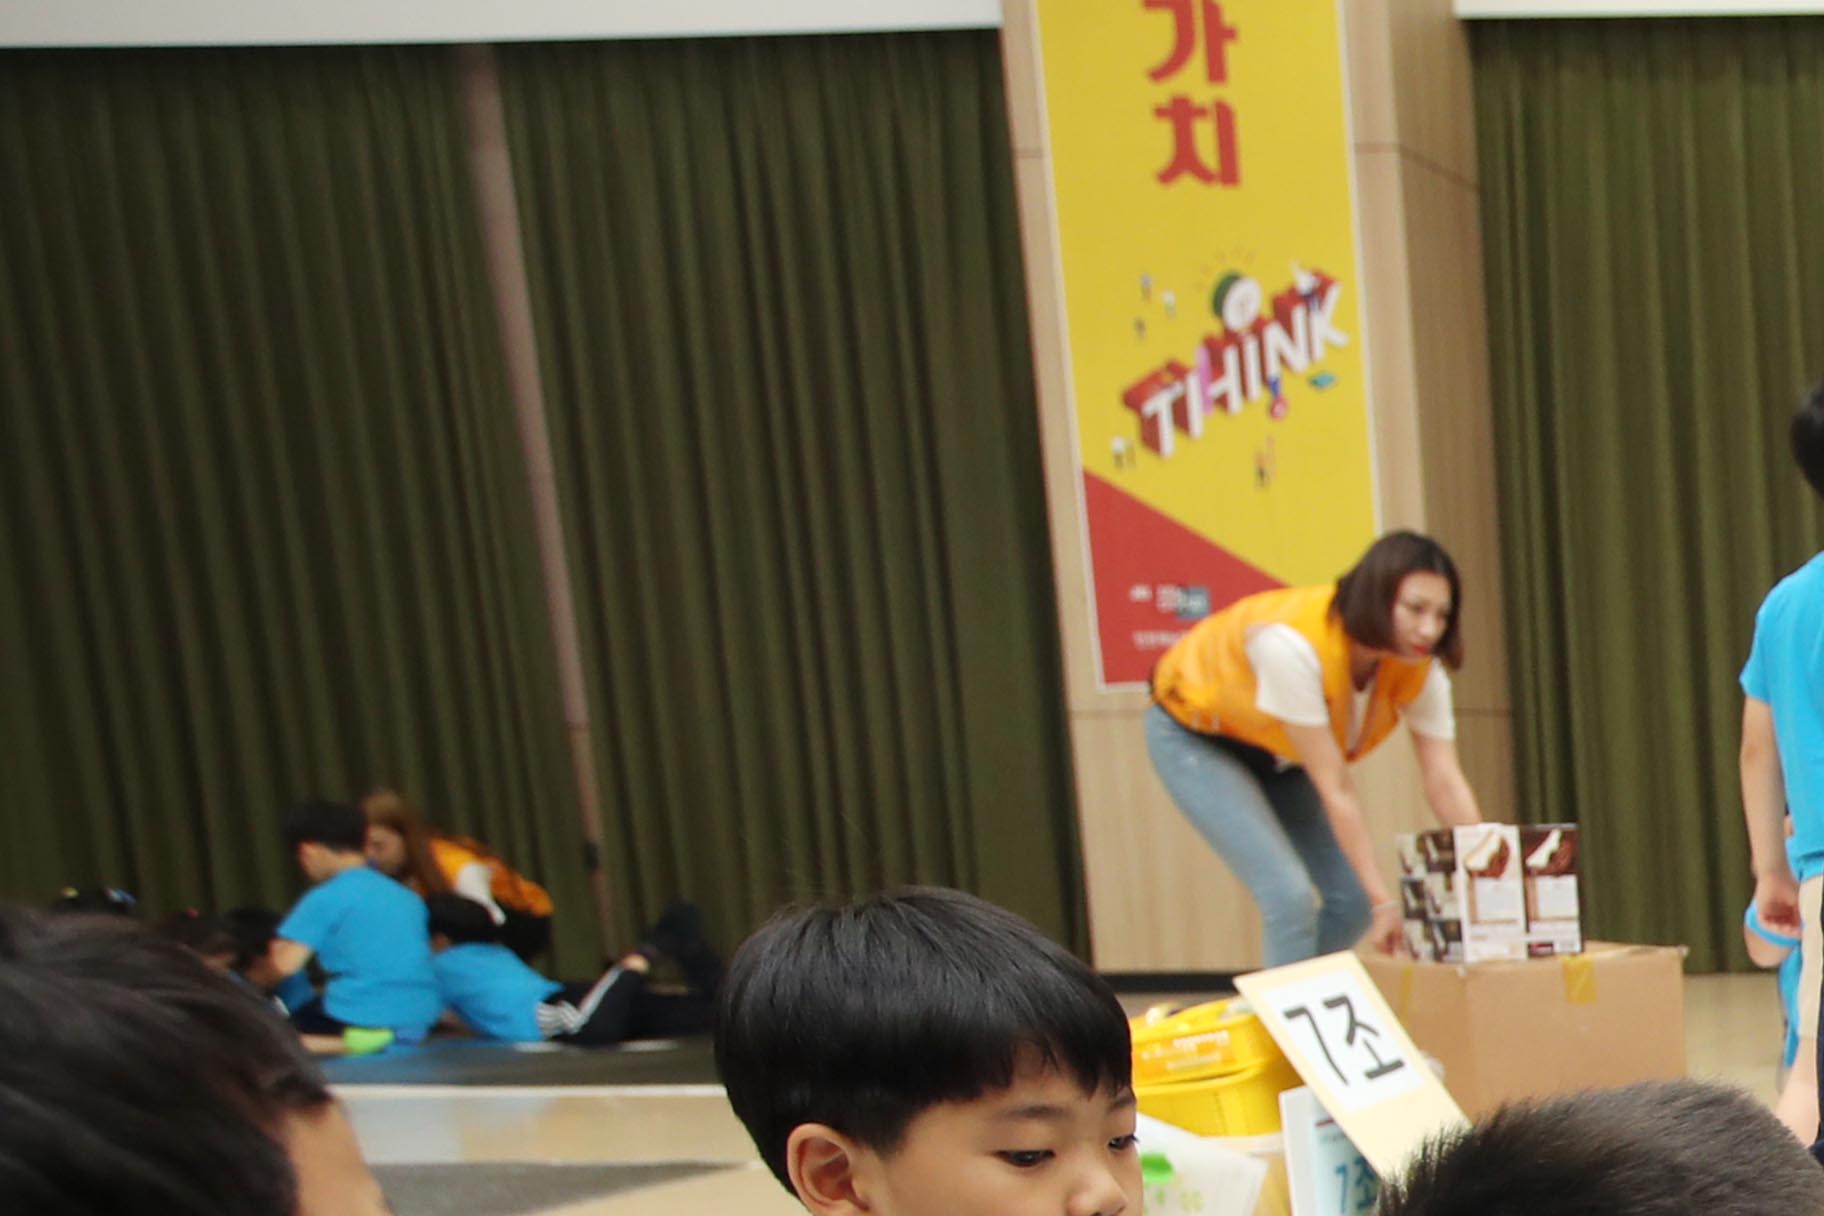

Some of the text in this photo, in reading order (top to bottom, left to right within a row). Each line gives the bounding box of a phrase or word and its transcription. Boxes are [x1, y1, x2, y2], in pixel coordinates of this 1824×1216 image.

[1143, 0, 1240, 188] 가치
[1130, 273, 1348, 458] THINK
[1282, 994, 1406, 1086] 7조
